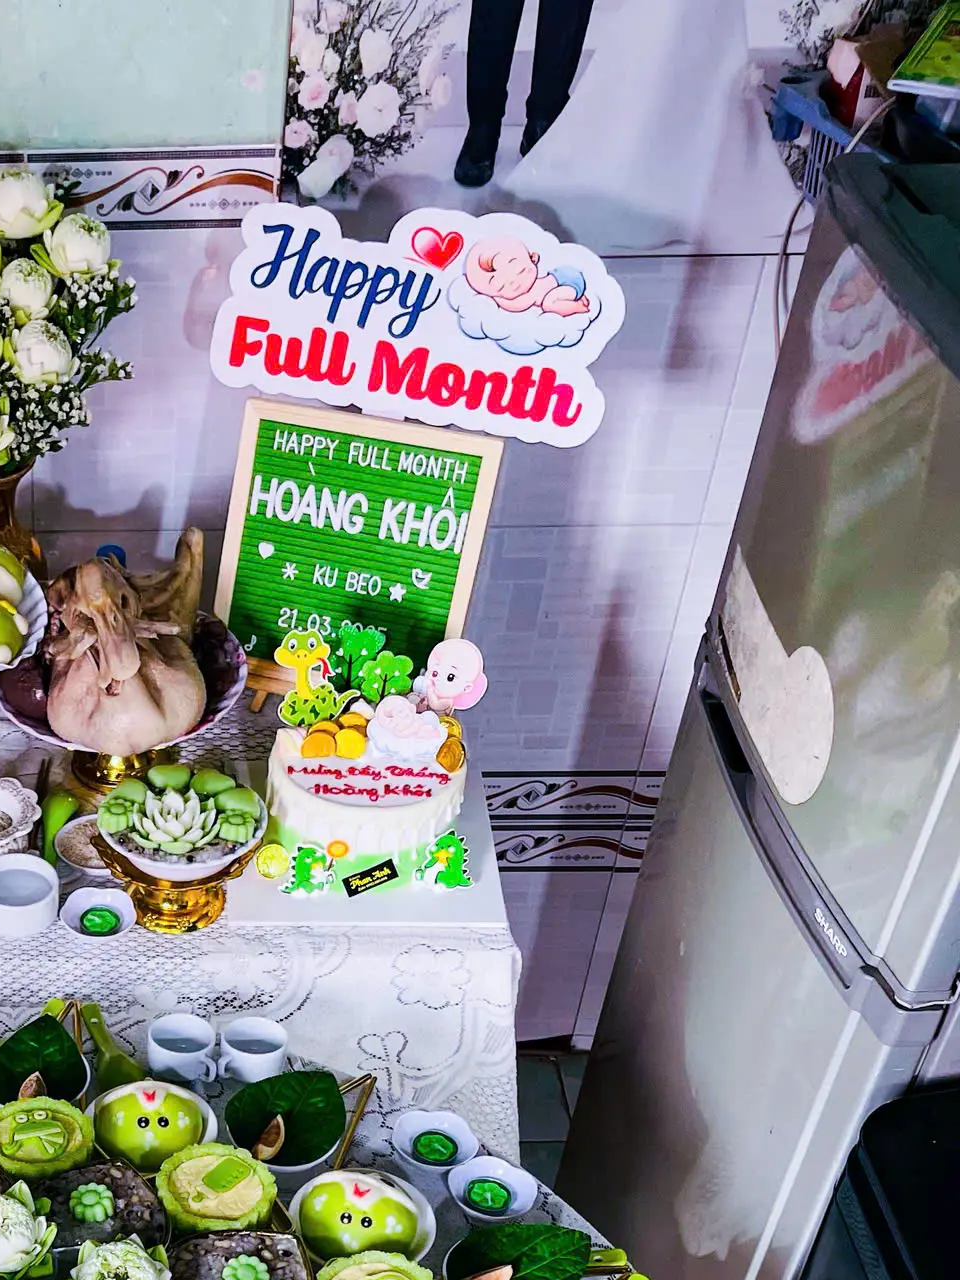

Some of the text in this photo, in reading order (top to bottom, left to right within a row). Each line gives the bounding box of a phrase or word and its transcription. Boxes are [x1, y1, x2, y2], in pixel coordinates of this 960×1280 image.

[250, 224, 442, 339] Happy
[229, 316, 582, 428] Full Month
[273, 429, 468, 485] HAPPY FULL MONTH
[249, 462, 470, 555] HOÀNG KHÔI
[313, 564, 382, 597] KU BEO
[314, 784, 432, 802] Hoàng Khôi
[814, 907, 848, 957] SHARP
